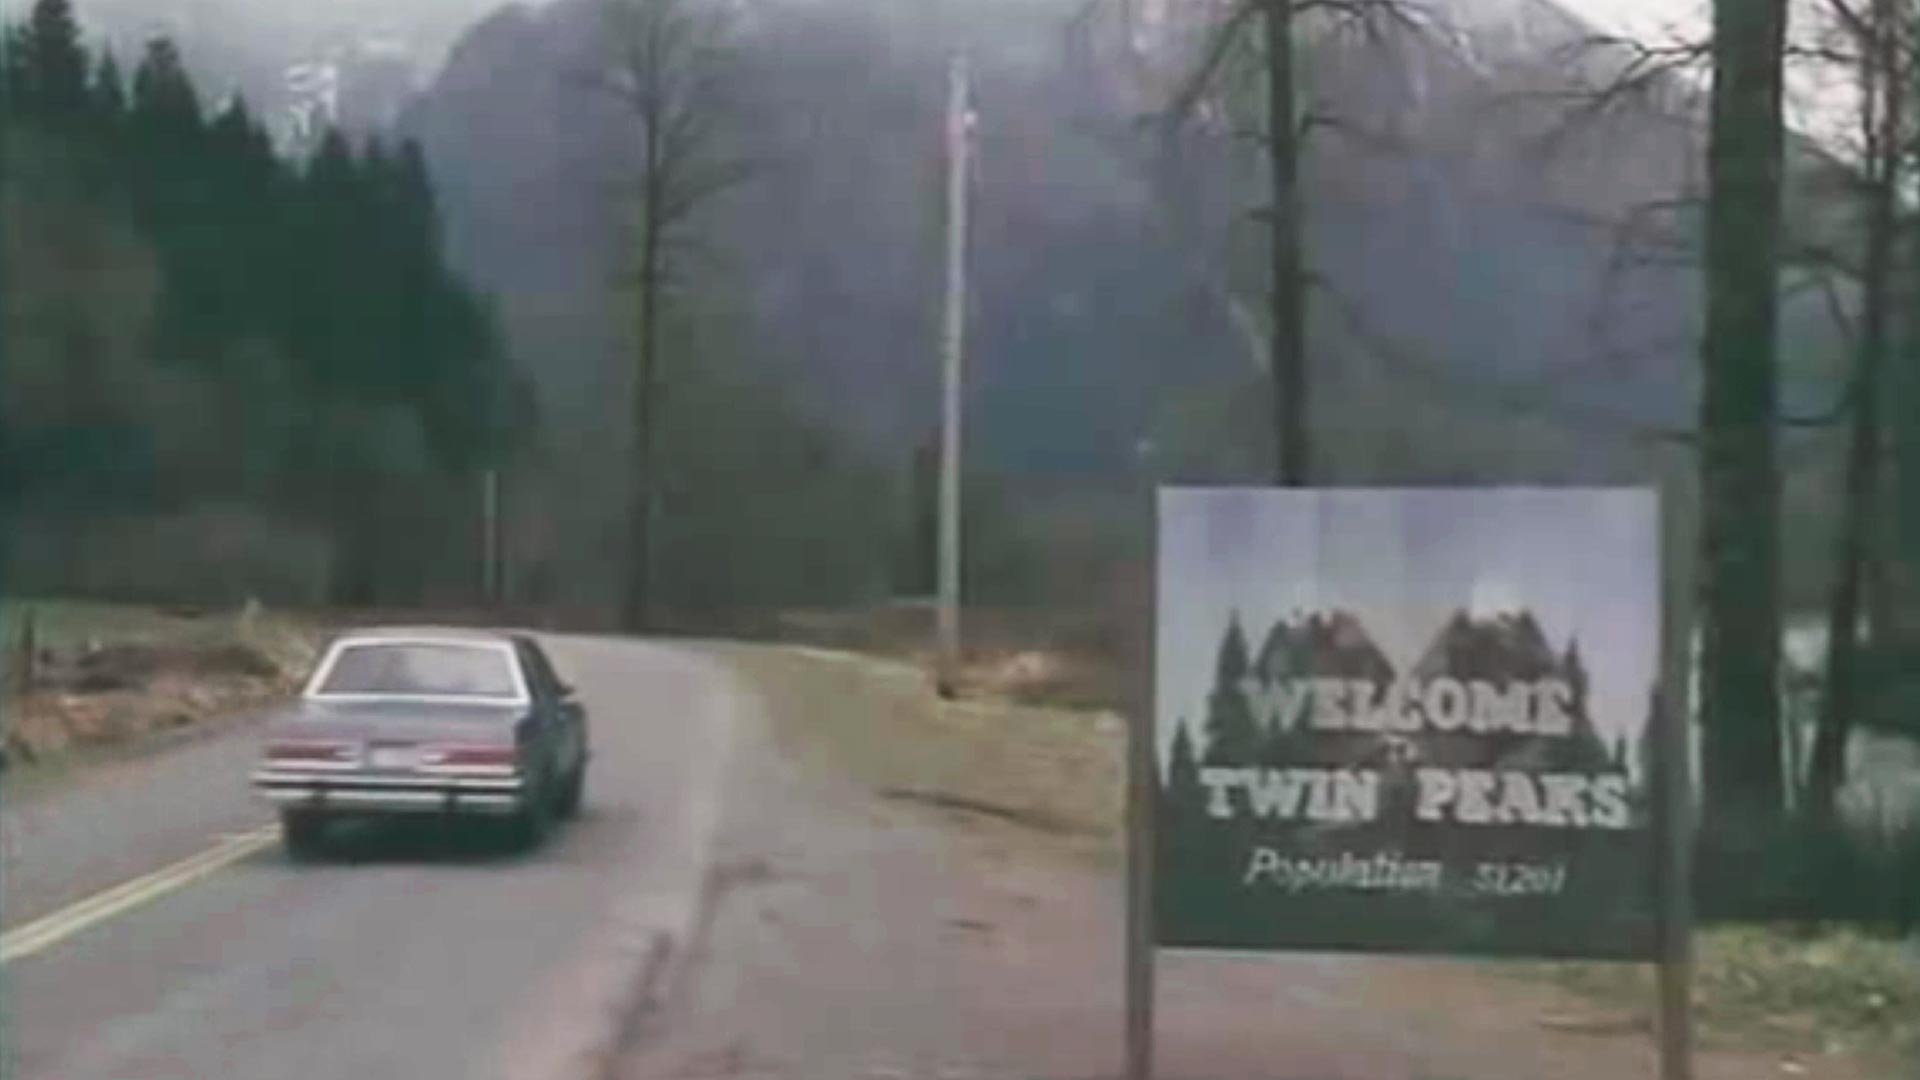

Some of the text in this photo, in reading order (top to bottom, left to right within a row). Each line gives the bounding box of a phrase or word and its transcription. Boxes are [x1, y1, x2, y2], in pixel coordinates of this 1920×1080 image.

[1240, 676, 1574, 735] WELCOME
[1199, 766, 1630, 829] TWIN PEAKS
[1243, 846, 1443, 894] Population
